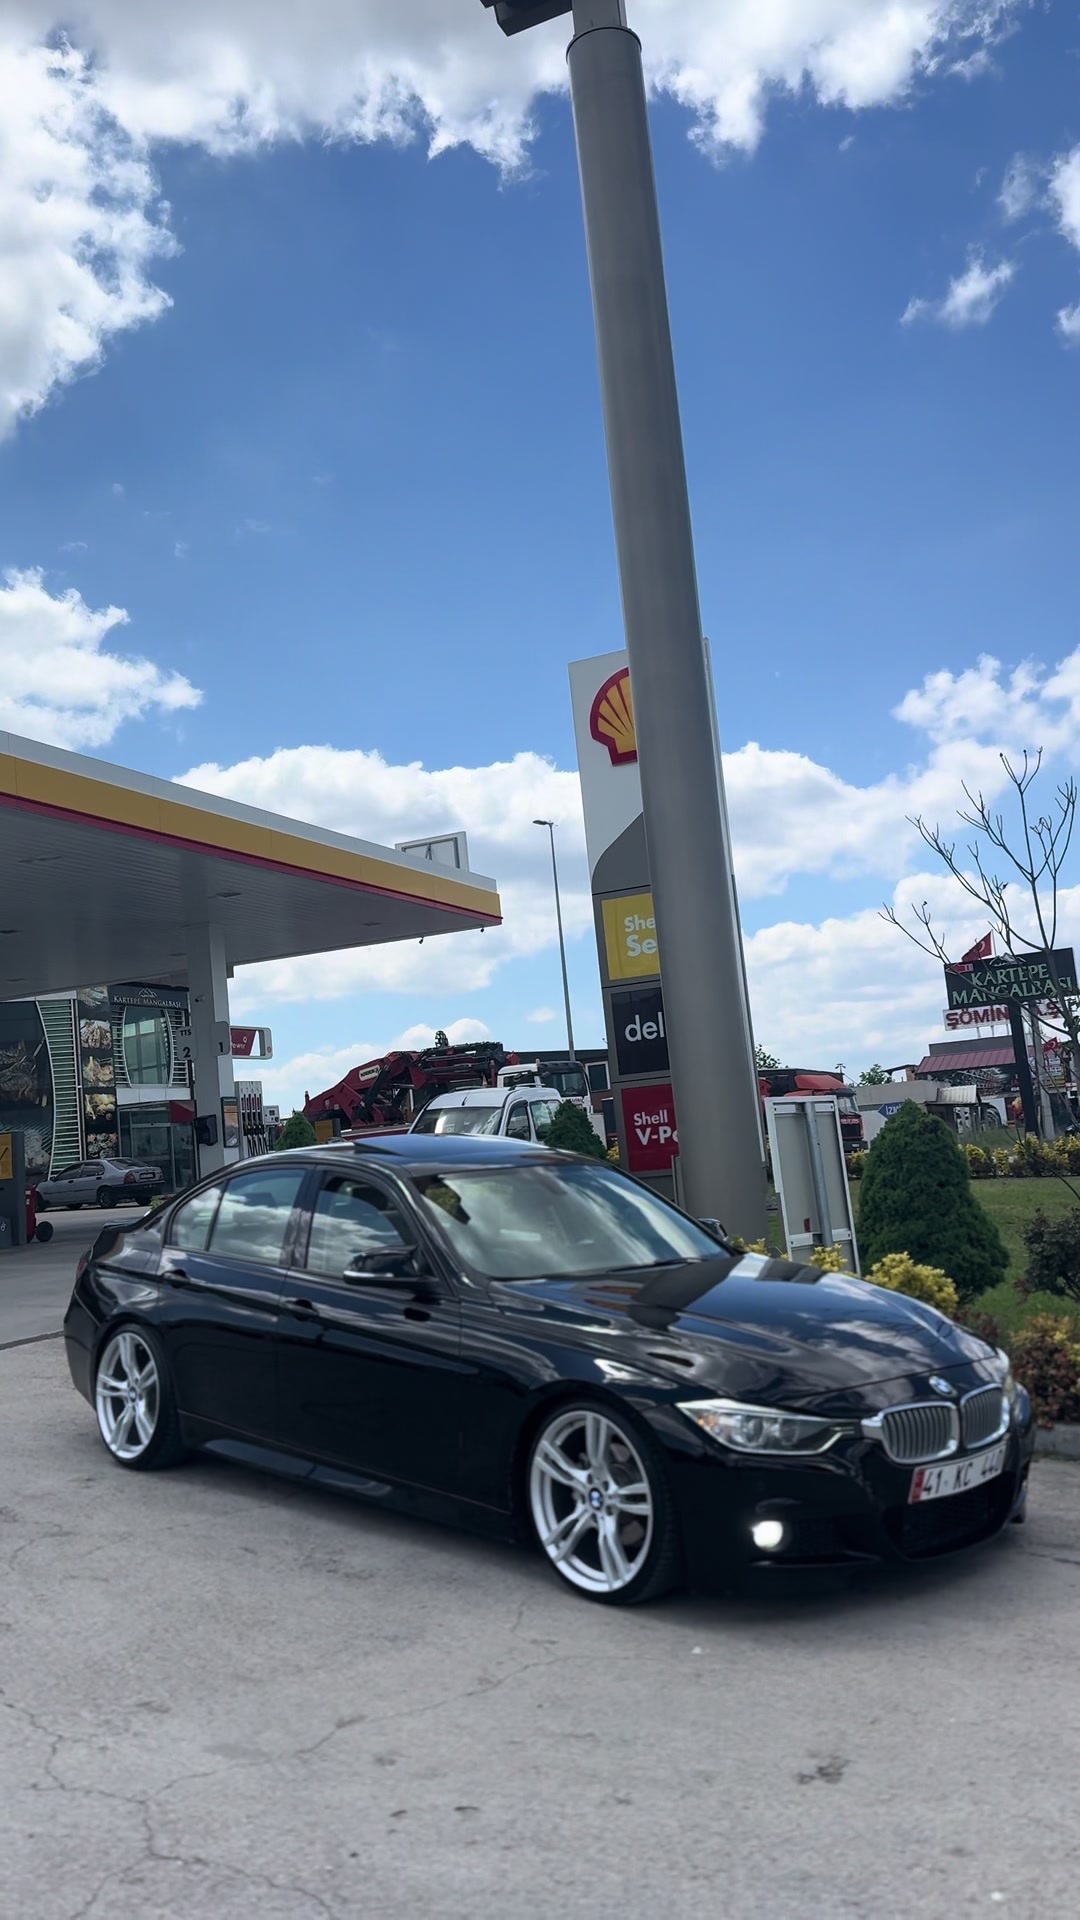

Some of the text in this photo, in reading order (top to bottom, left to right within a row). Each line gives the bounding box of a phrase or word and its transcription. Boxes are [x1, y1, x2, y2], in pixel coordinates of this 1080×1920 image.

[626, 934, 657, 957] Se
[970, 963, 1050, 987] KARTEPE
[180, 1028, 192, 1037] TTS
[625, 1011, 665, 1042] del
[182, 1046, 192, 1058] 2
[219, 1041, 224, 1054] 1
[633, 1109, 669, 1127] Shell
[923, 1468, 943, 1496] 41
[952, 1461, 974, 1491] KC
